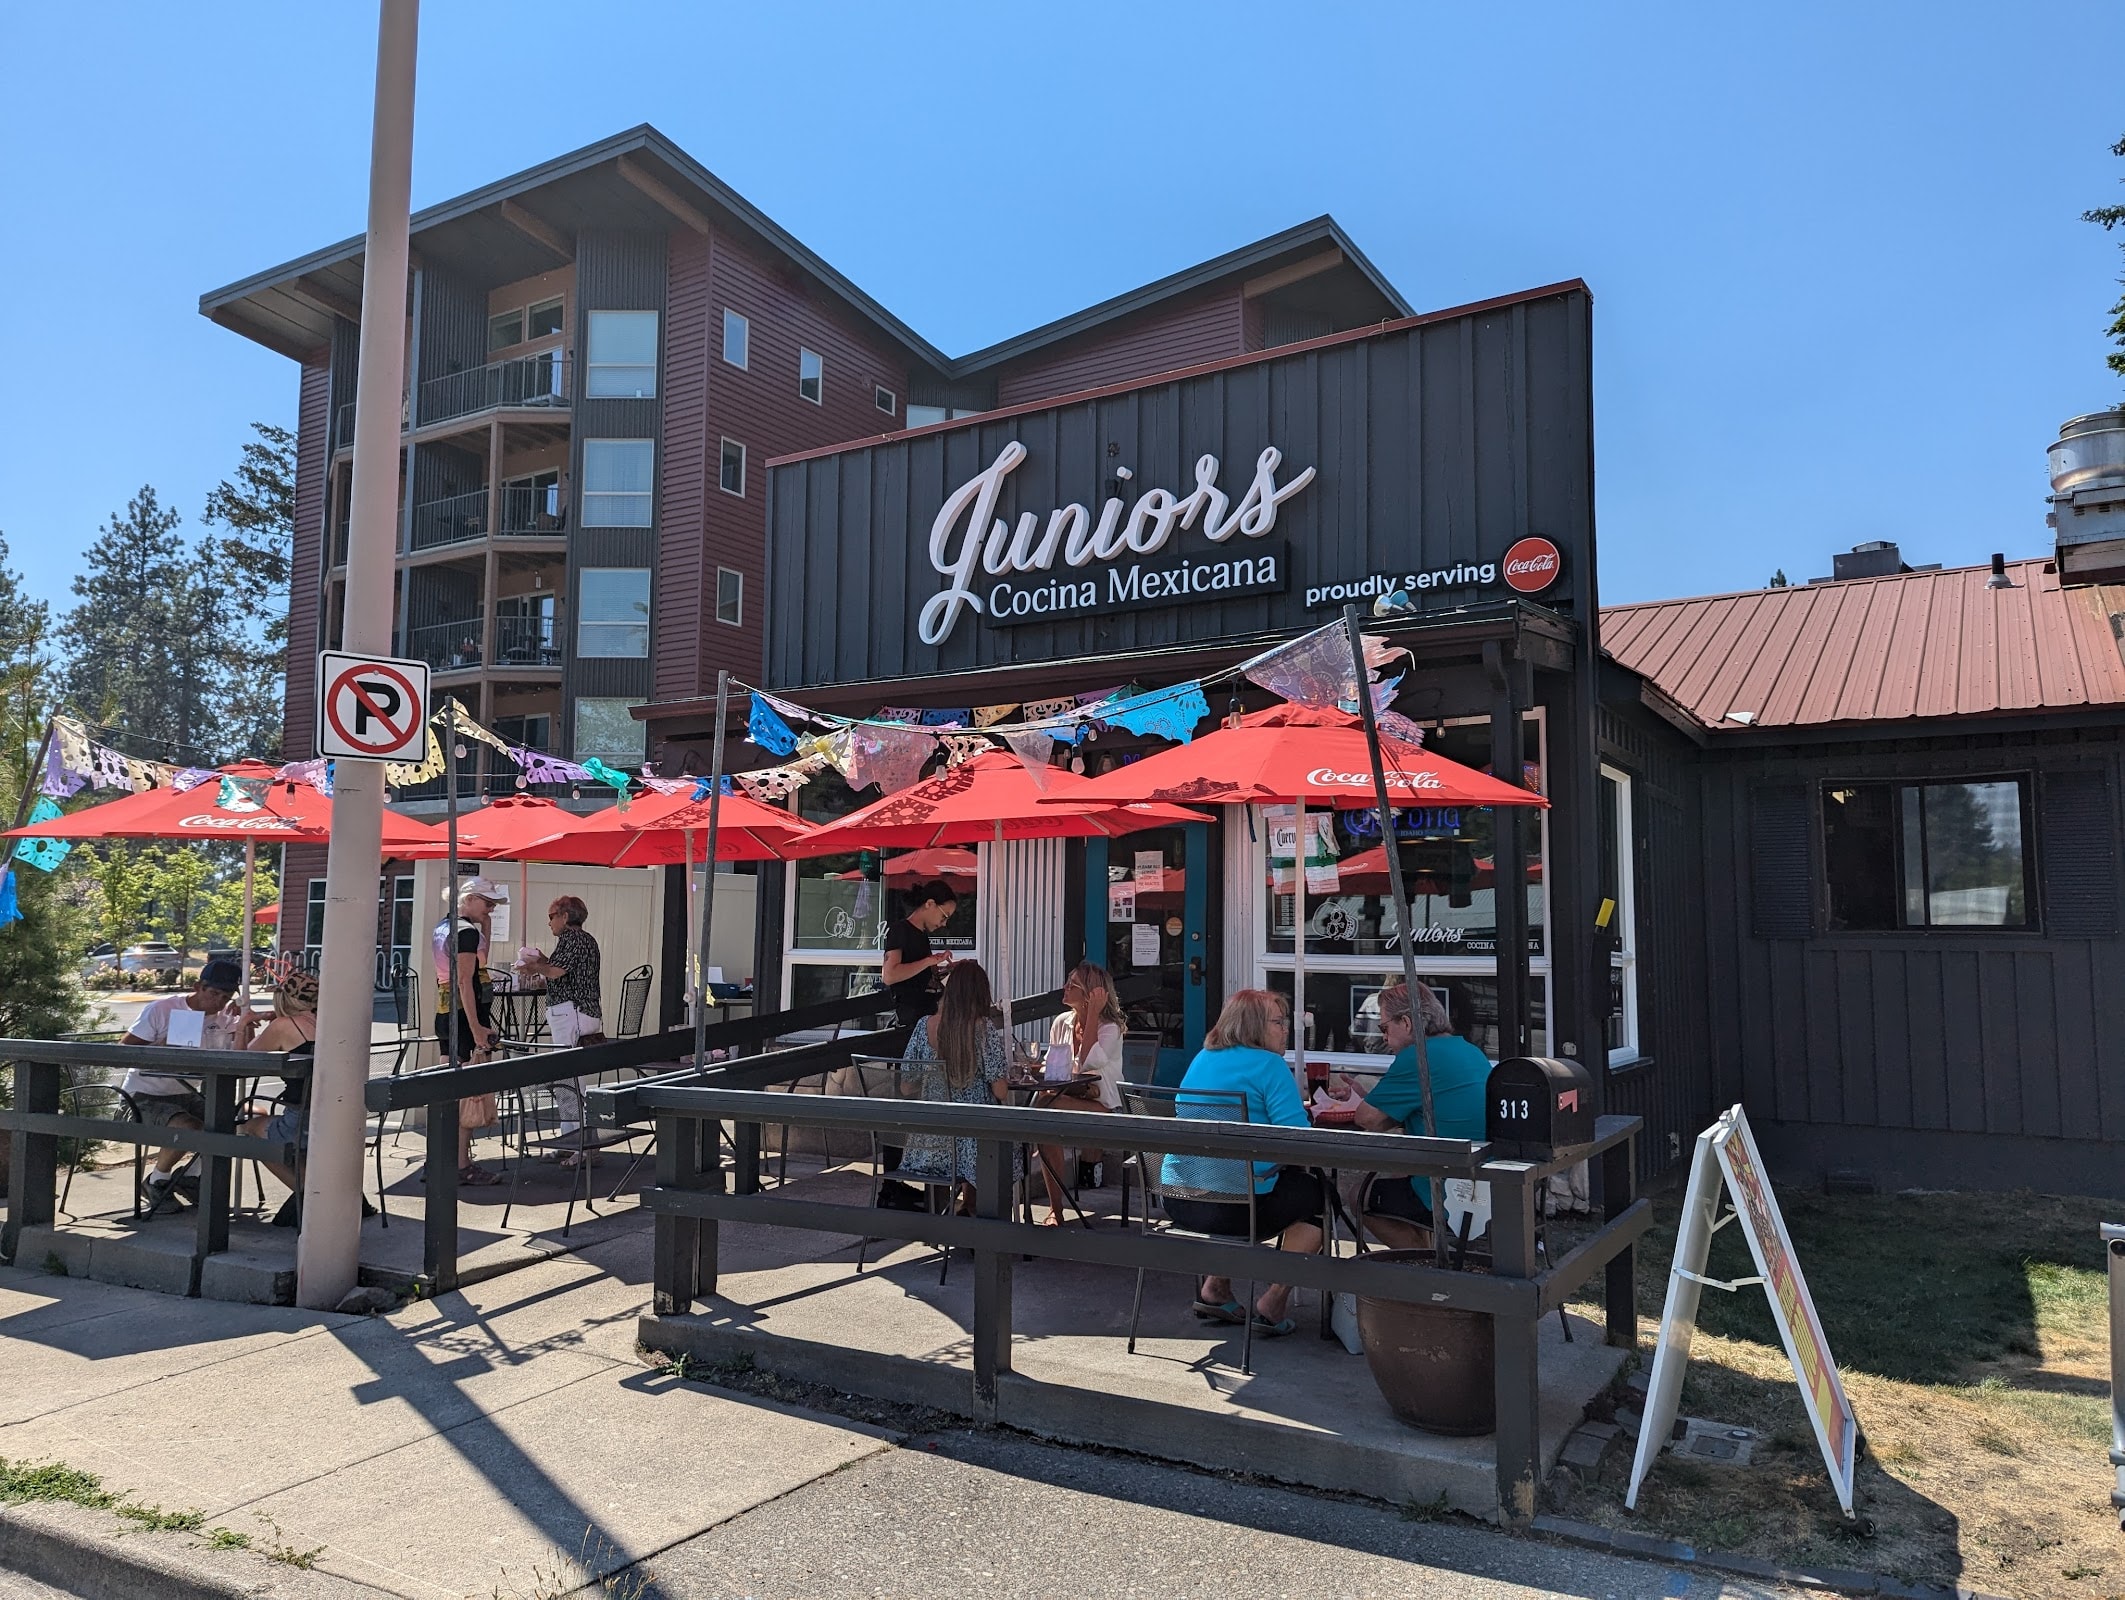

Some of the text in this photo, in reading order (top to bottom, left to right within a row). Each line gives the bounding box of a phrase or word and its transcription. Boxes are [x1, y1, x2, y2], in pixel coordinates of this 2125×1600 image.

[918, 440, 1317, 646] Juniors
[1507, 553, 1556, 576] Coca-Cola
[988, 555, 1277, 618] Cocina Mexicana
[1305, 563, 1496, 607] proudly serving
[1500, 1099, 1529, 1120] 313
